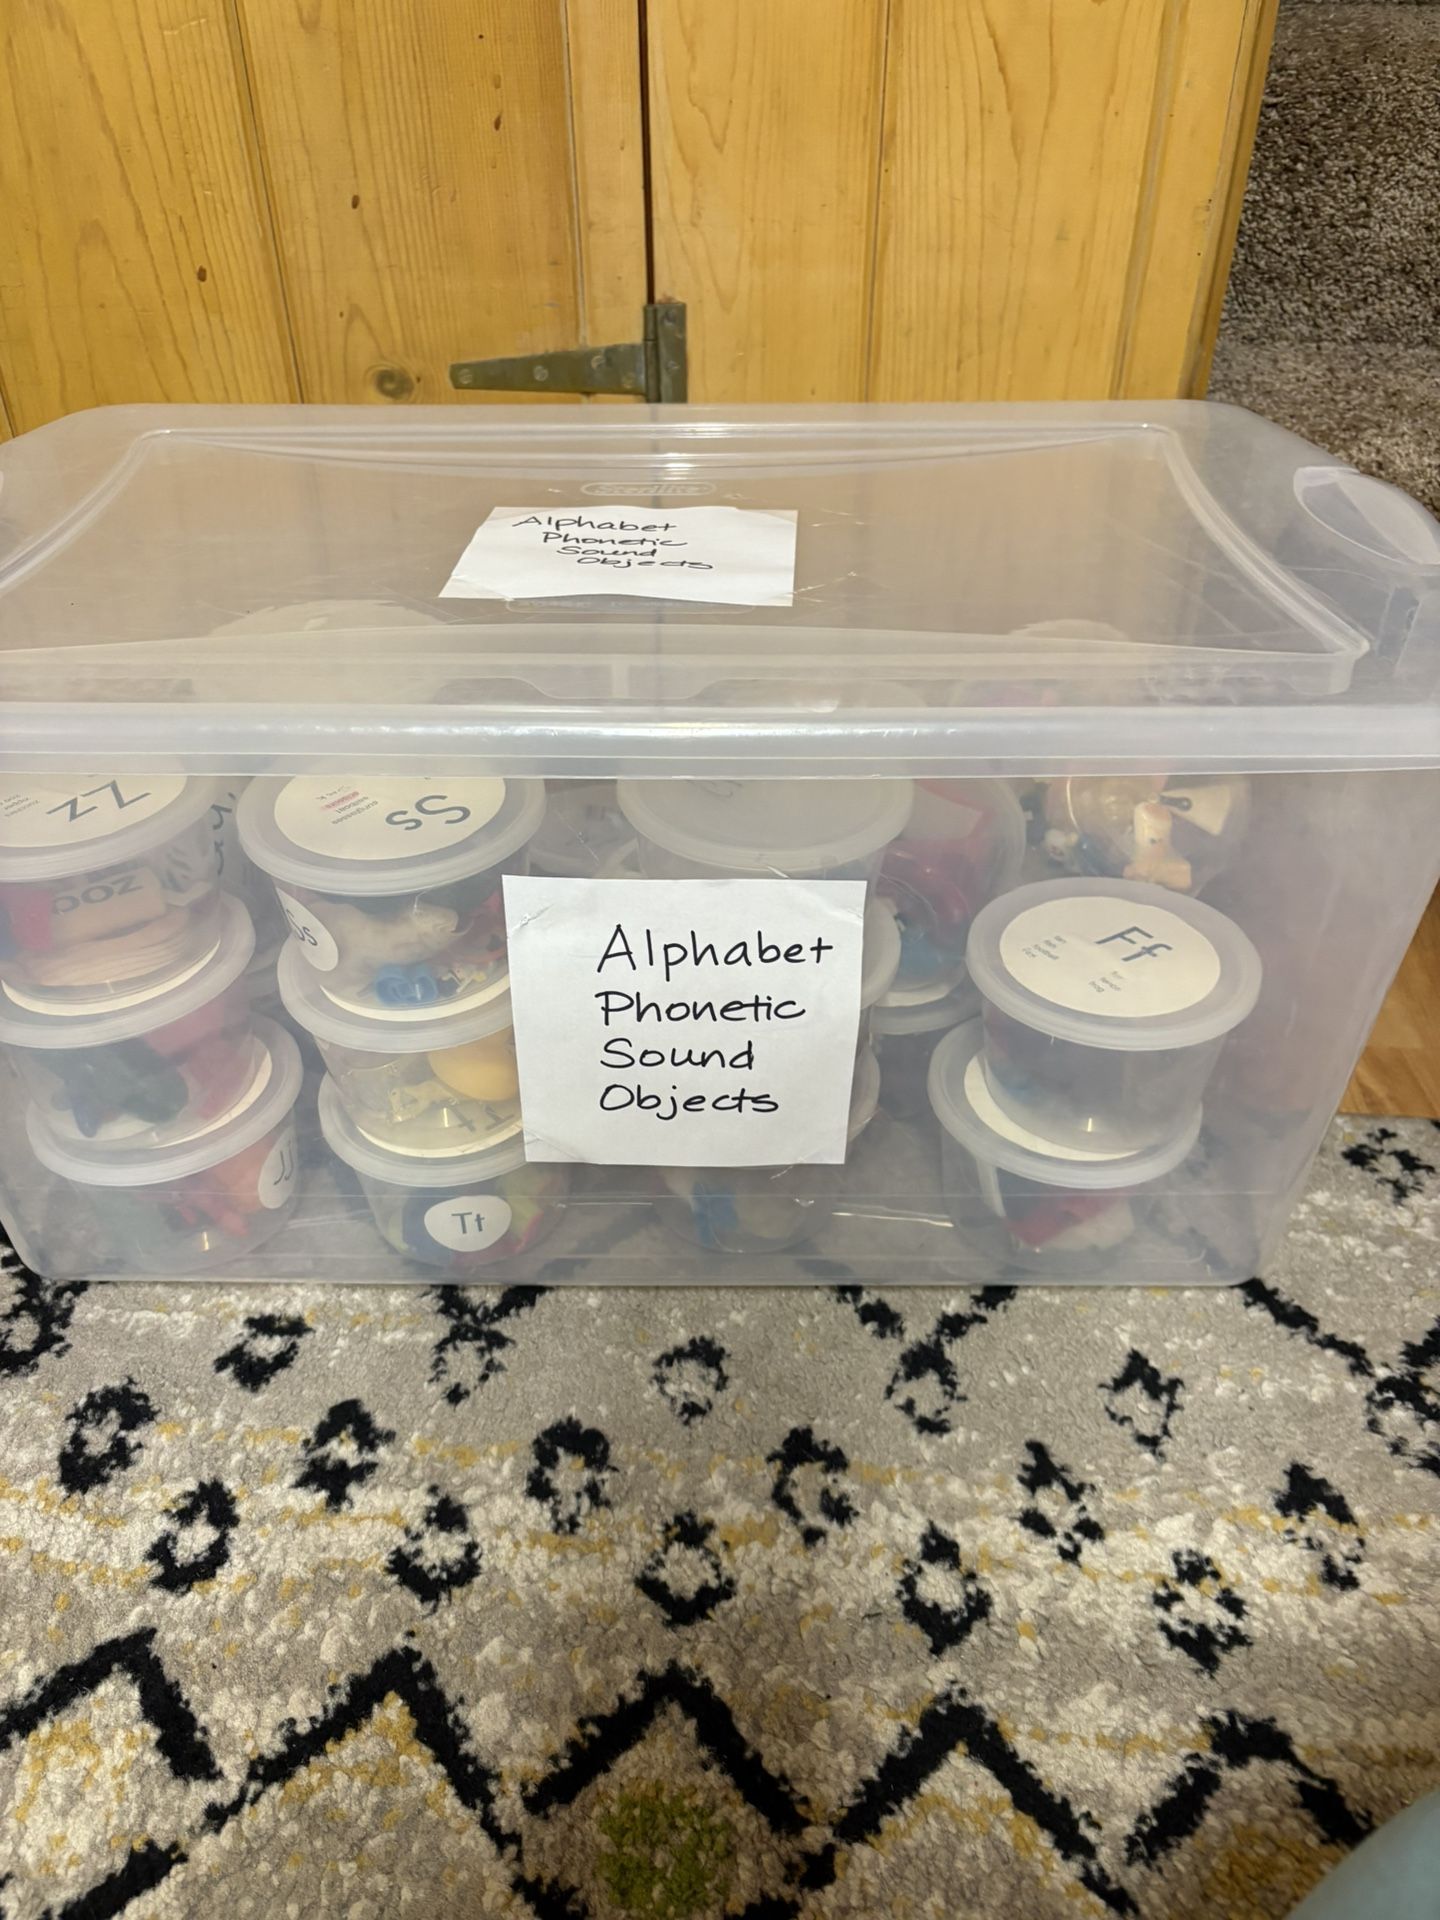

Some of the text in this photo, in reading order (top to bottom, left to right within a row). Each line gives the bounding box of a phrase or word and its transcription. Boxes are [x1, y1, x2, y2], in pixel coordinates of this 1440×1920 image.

[512, 516, 677, 531] Alphabet
[542, 531, 688, 545] Phonetic
[556, 546, 657, 557] Sound
[577, 557, 713, 568] Objects
[597, 924, 834, 982] Alphabet
[1094, 926, 1173, 962] Ff
[595, 991, 806, 1026] Phonetic
[600, 1037, 755, 1070] Sound
[599, 1084, 779, 1120] Objects
[451, 1211, 486, 1235] Tt
